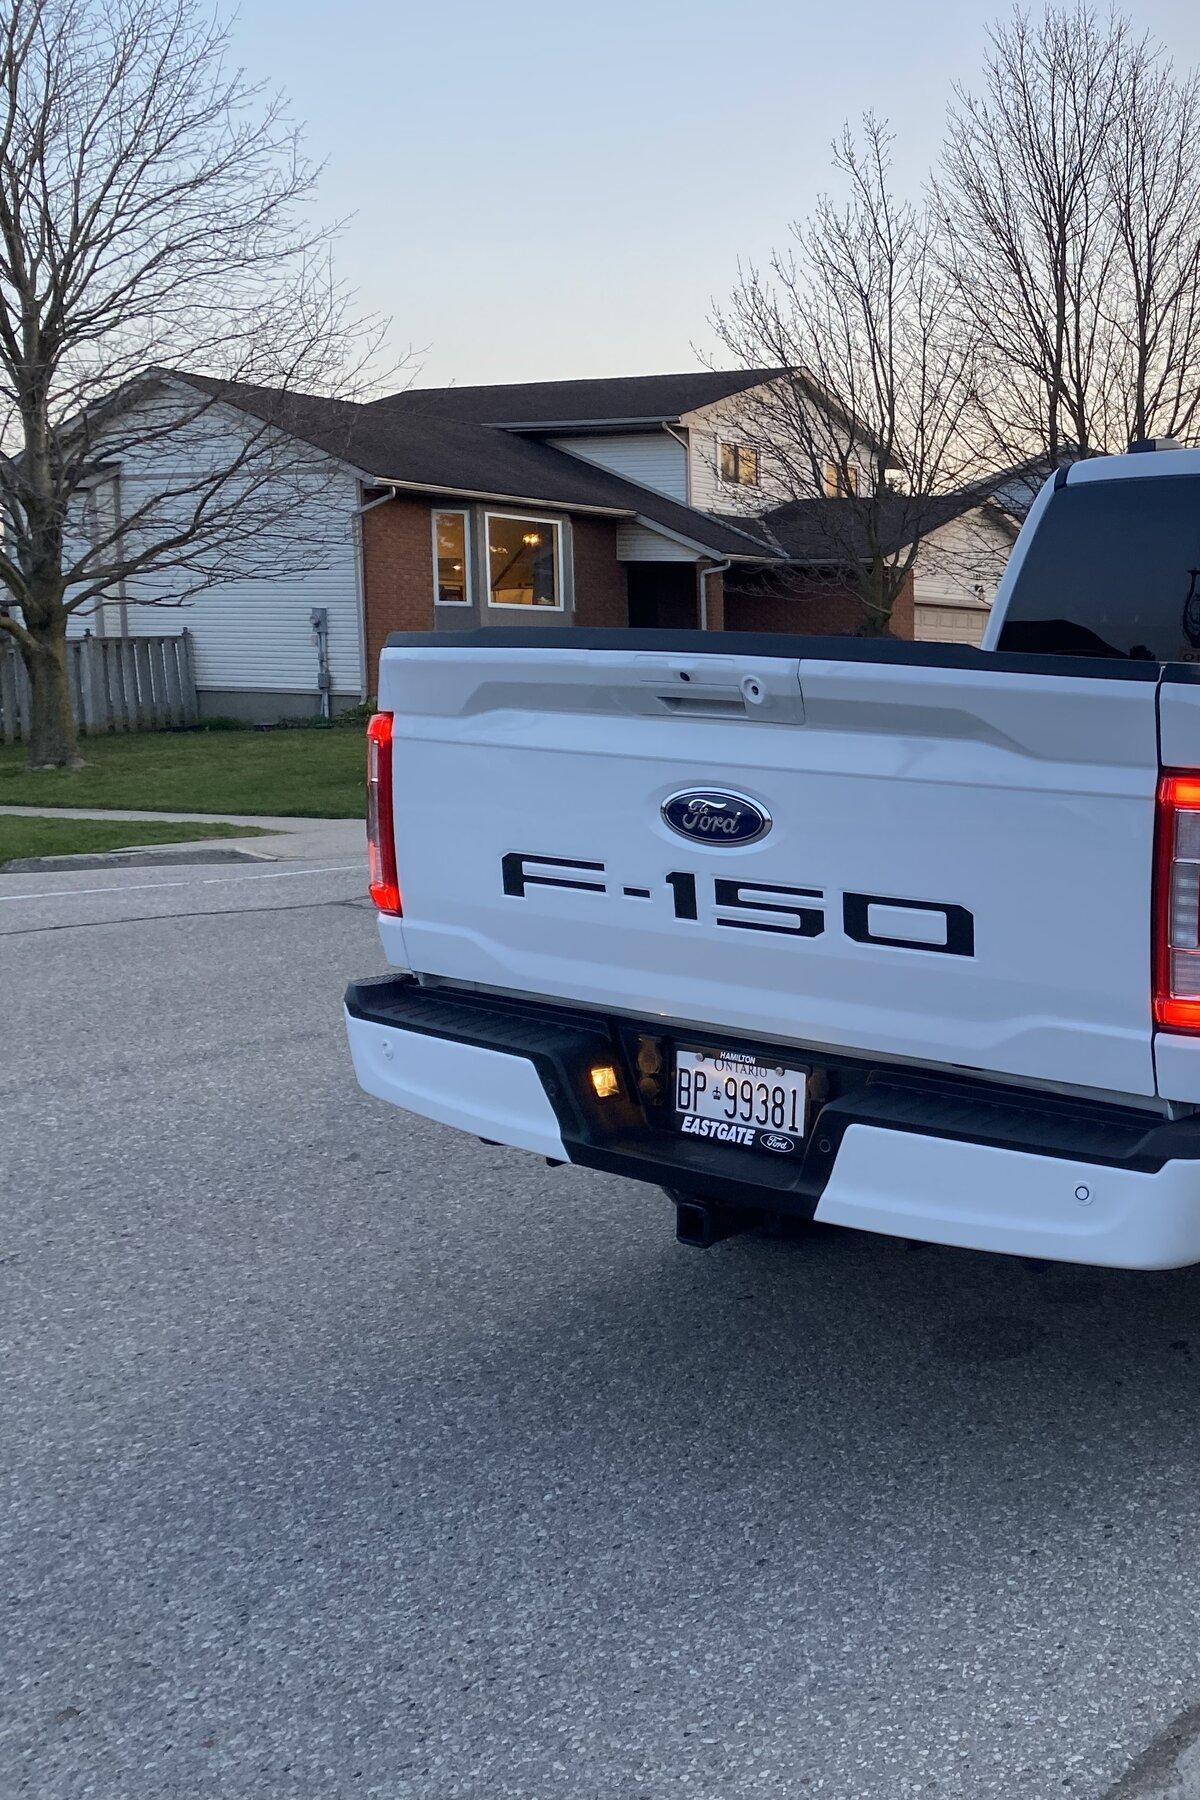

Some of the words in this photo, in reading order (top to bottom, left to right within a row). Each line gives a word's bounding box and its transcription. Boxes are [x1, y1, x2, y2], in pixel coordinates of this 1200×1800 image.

[682, 798, 741, 834] Ford
[501, 852, 975, 957] F-150
[714, 1059, 767, 1078] ONTARIO
[720, 1051, 756, 1065] HAMILTON
[678, 1068, 707, 1112] BP
[724, 1077, 799, 1133] 99381
[681, 1116, 756, 1146] EASTGATE
